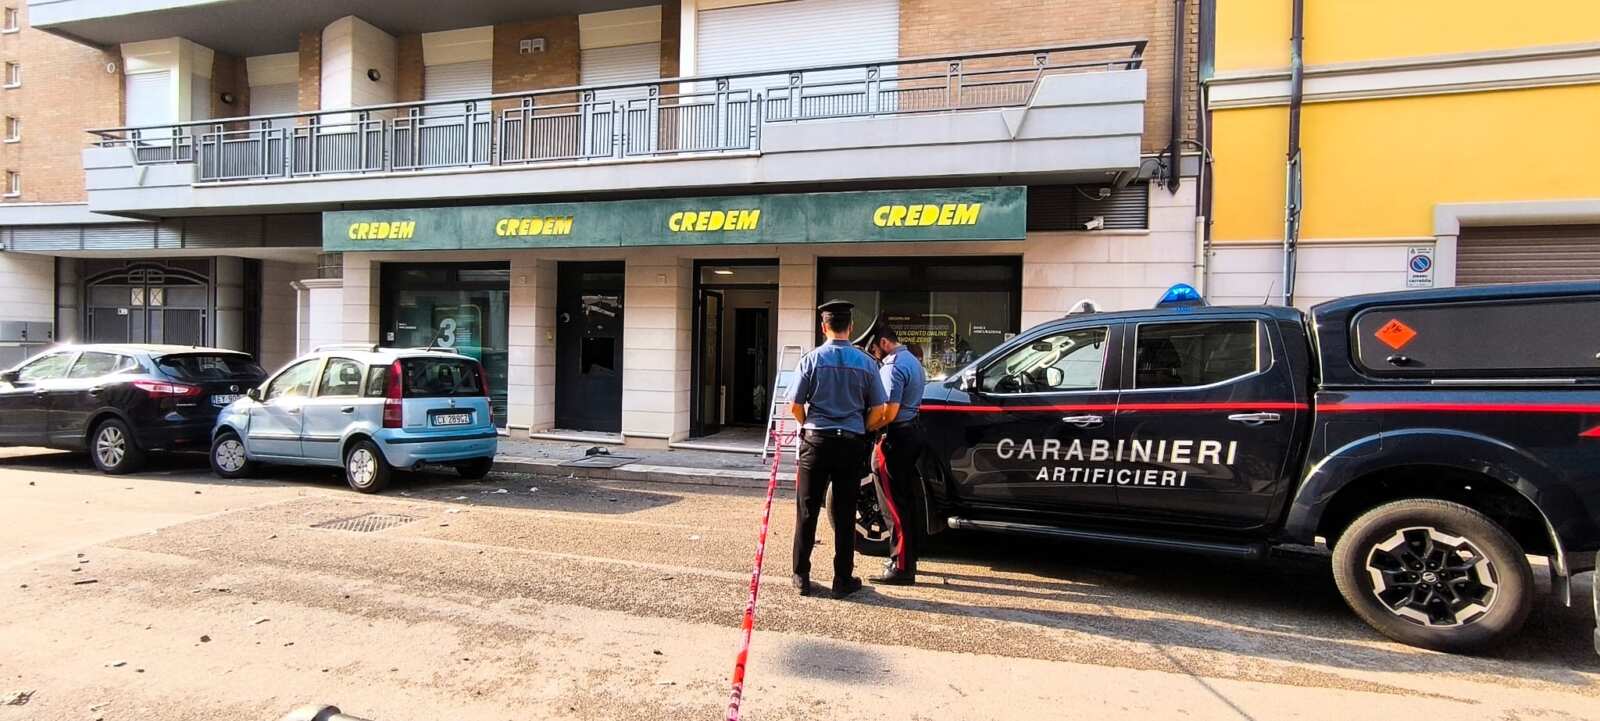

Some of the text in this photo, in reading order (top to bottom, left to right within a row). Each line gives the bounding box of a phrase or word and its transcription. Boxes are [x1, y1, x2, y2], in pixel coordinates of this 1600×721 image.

[496, 215, 574, 237] CREDEM
[668, 209, 760, 232] CREDEM
[873, 203, 981, 228] CREDEM
[349, 221, 416, 240] CREDEM
[437, 318, 457, 348] 3
[996, 438, 1238, 465] CARABINIERI
[1036, 466, 1188, 487] ARTIFICIERI
